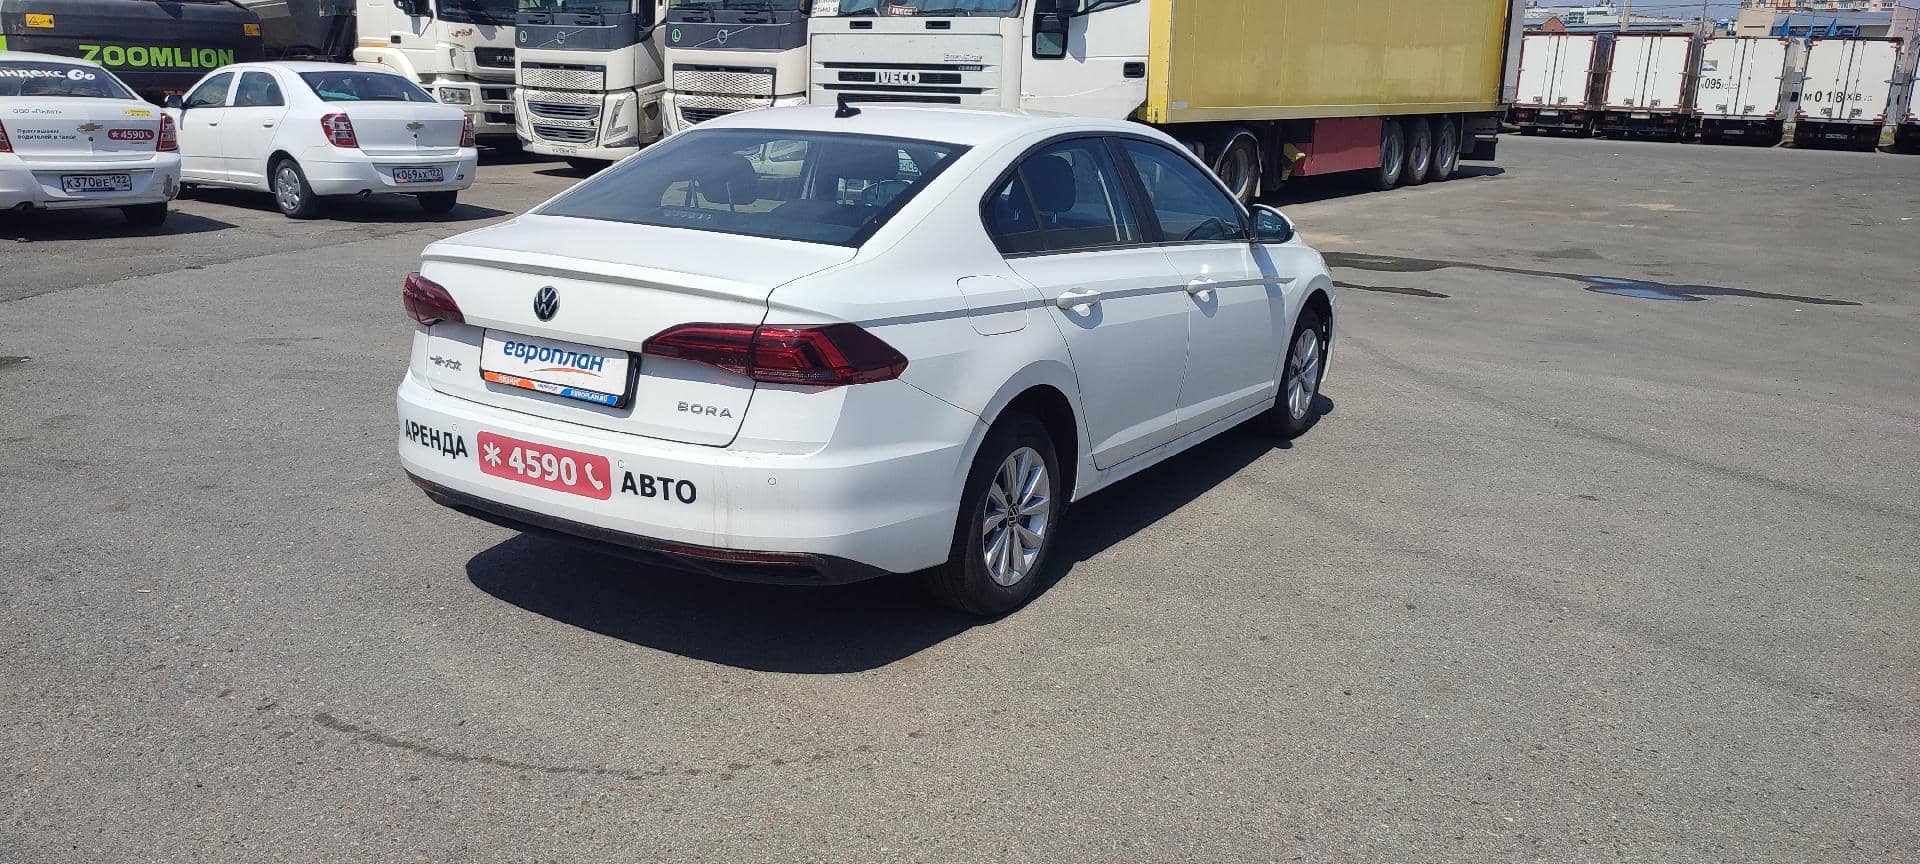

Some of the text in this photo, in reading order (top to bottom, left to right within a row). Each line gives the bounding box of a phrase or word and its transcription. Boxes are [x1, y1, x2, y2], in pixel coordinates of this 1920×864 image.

[78, 45, 235, 68] ZOOMLION
[67, 69, 96, 80] Go
[875, 71, 920, 84] IVECO
[504, 340, 605, 372] европлан
[677, 400, 733, 419] BORA
[405, 419, 468, 459] АРЕНДА
[621, 471, 697, 504] АВТО
